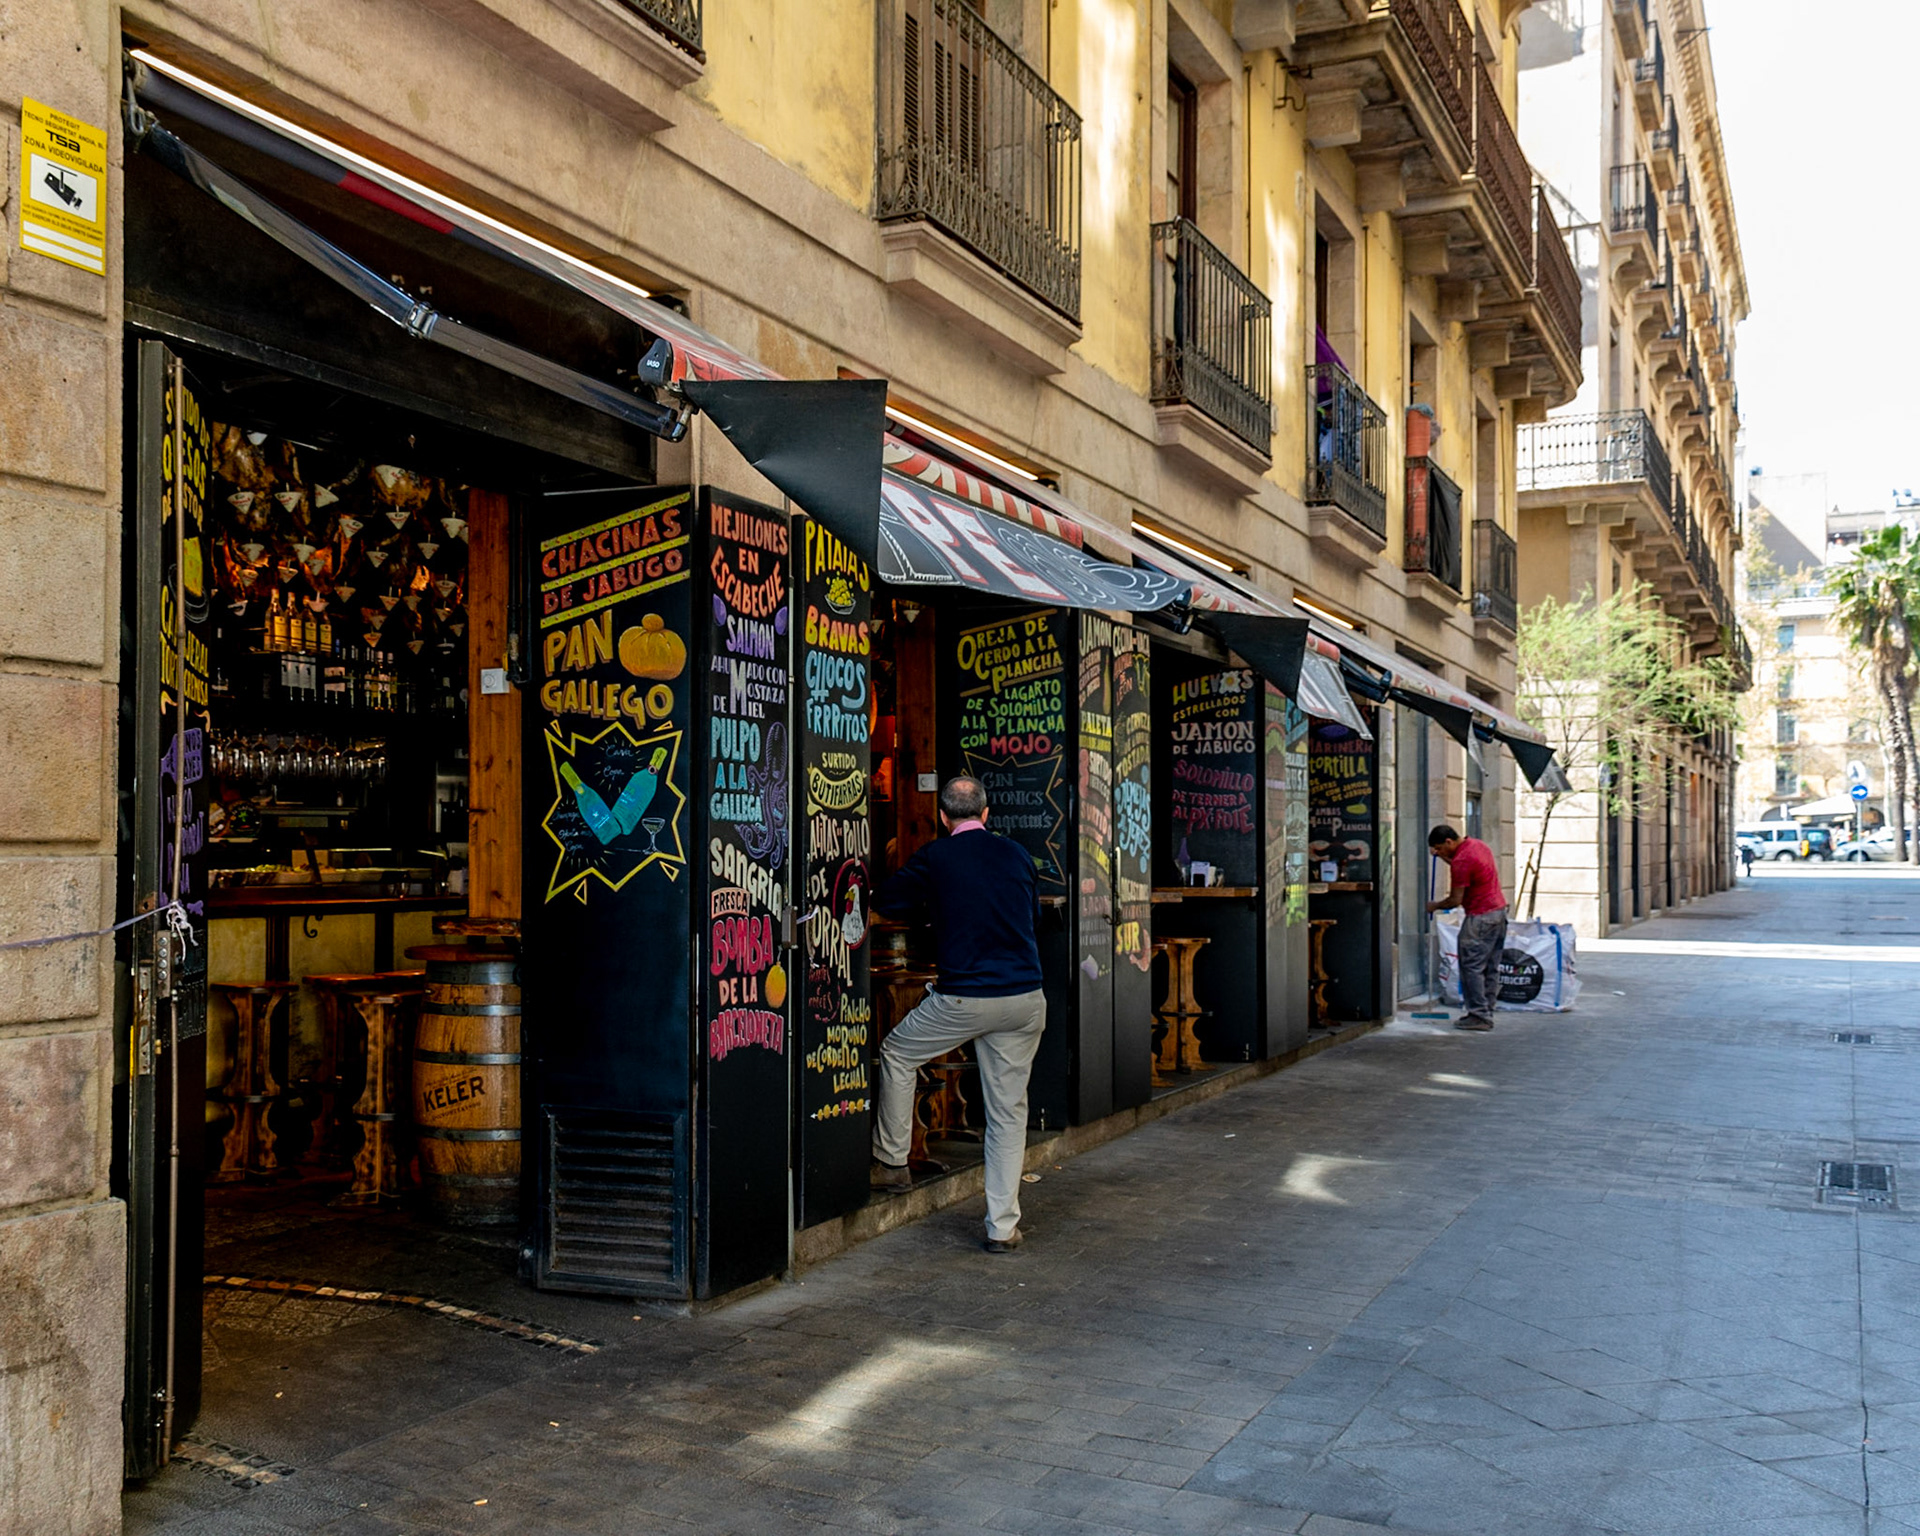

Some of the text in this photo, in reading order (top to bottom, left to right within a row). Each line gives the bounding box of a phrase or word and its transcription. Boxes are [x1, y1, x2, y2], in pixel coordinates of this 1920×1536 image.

[24, 110, 43, 123] TECNO
[45, 120, 76, 137] SEGURETAT
[50, 113, 80, 130] PROTEGIT
[24, 135, 104, 174] ZONA VIDEOVIGILADA
[542, 509, 682, 578] CHACINAS
[710, 502, 788, 556] MEJILLONES
[738, 547, 759, 576] EN
[544, 549, 683, 615] DE JABUGO
[710, 544, 785, 618] ESCABECHE
[544, 609, 614, 677] PAN
[726, 614, 775, 661] SALMON
[805, 604, 870, 655] BRAVAS
[957, 617, 1048, 670] OREJA DE
[1079, 614, 1112, 657] JAMON
[975, 633, 1058, 680] CERDO A LA
[992, 651, 1063, 694] PLANCHA
[711, 655, 787, 698] AHUMADO CON
[805, 649, 866, 709] CHOCOS
[1004, 679, 1061, 702] LAGARTO
[540, 678, 675, 729] GALLEGO
[713, 695, 727, 713] DE
[966, 698, 984, 711] DE
[1173, 694, 1247, 723] ESTRELLADOS
[1215, 707, 1239, 719] CON
[806, 697, 868, 744] FRRRITOS
[961, 714, 1065, 735] A LA PLANCHA
[1081, 711, 1112, 738] PALETA
[1171, 720, 1255, 742] JAMON
[711, 715, 761, 763] PULPO
[960, 732, 1052, 756] CON MOJO
[1173, 740, 1256, 755] DE JABUGO
[715, 762, 748, 790] A LA
[821, 752, 857, 769] SURTIDO
[812, 773, 862, 806] BUTIFARRAS
[981, 771, 1014, 790] GIN
[711, 791, 763, 822] GALLEGA
[988, 790, 1044, 806] TONICS
[1172, 789, 1248, 807] DE TERNERA
[843, 817, 871, 867] POLLO
[810, 866, 829, 901] DE
[713, 891, 748, 913] FRESCA
[710, 914, 774, 976] BOMBA
[1115, 921, 1141, 955] SUR
[718, 976, 758, 1006] DE LA
[709, 1007, 785, 1061] BARCELONETA
[806, 1050, 817, 1069] DE
[423, 1075, 486, 1113] KELER
[833, 1063, 867, 1094] LECHAL
